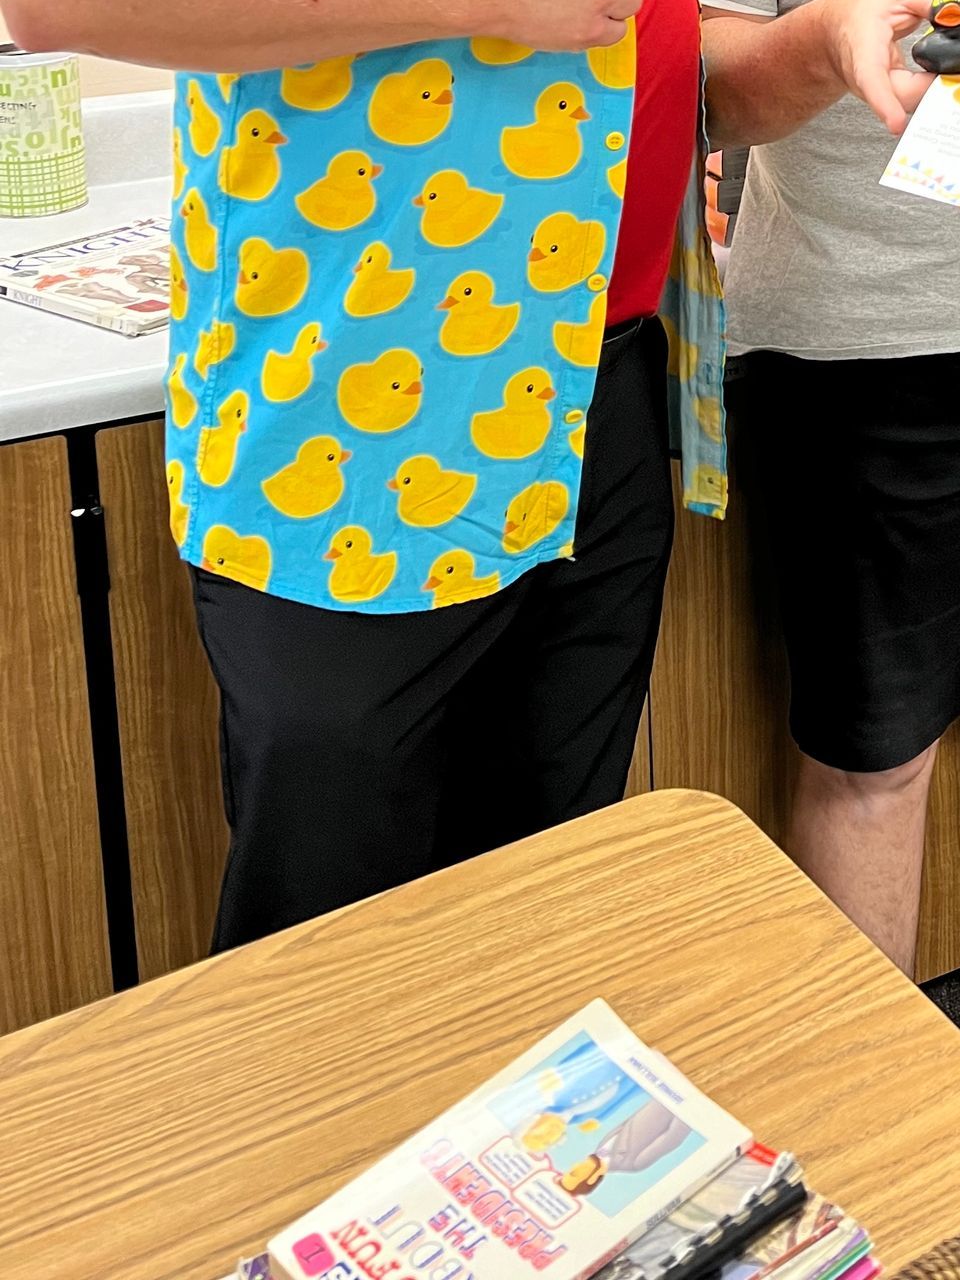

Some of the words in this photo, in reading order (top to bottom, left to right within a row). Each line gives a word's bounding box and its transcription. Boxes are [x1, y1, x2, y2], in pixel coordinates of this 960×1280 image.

[13, 290, 43, 307] KNIGHT
[420, 1137, 569, 1271] PRESIDENTS
[427, 1204, 488, 1261] THE
